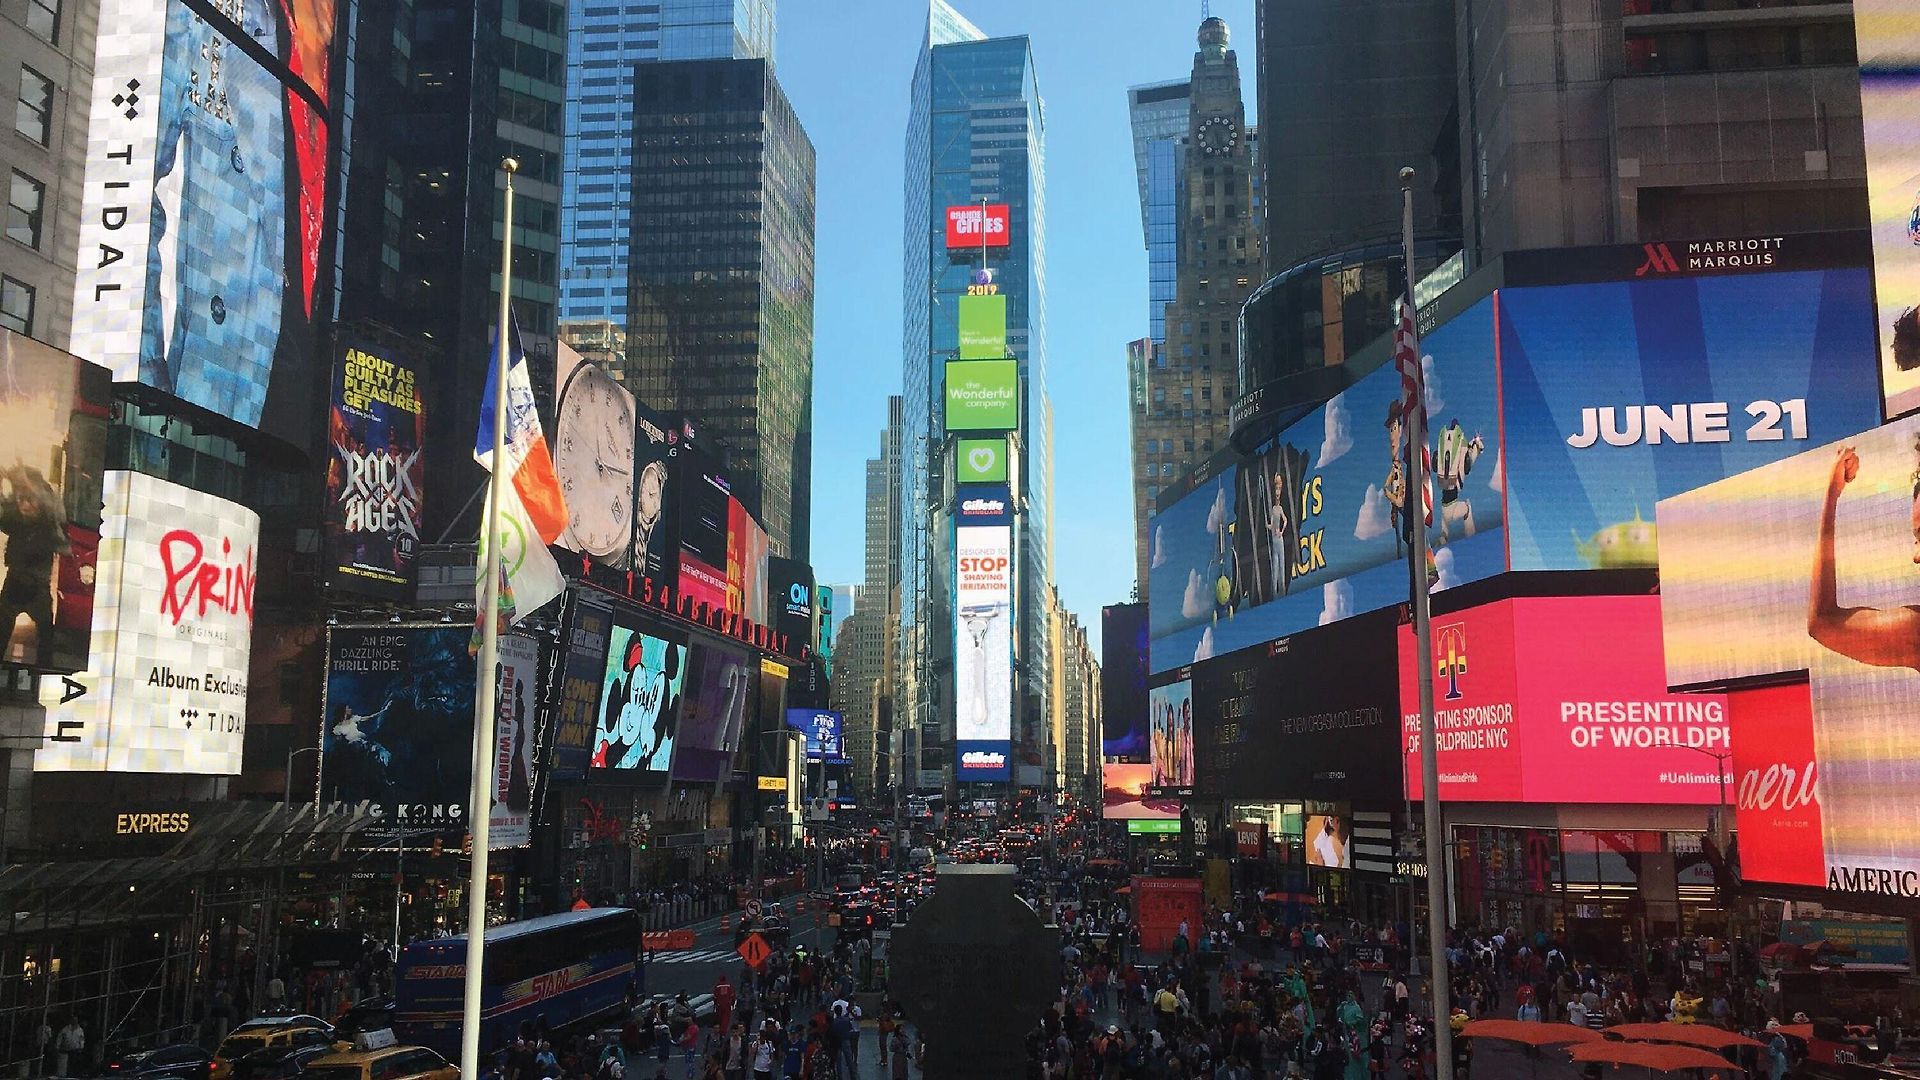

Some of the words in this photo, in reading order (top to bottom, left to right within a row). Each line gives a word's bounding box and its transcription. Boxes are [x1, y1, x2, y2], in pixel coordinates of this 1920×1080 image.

[94, 144, 133, 302] TIDAL
[1689, 237, 1784, 253] MARRIOTT
[1689, 253, 1774, 268] MARQUIS
[967, 285, 997, 296] 2019
[345, 348, 395, 377] ABOUT
[396, 367, 415, 384] AS
[345, 362, 393, 390] GUILTY
[395, 381, 413, 398] AS
[965, 381, 980, 390] the
[343, 390, 373, 413] GET.
[344, 375, 422, 415] PLEASURES
[949, 386, 1014, 400] Wonderful
[1567, 402, 1731, 449] JUNE
[1745, 398, 1808, 441] 21
[338, 440, 422, 502] ROCK
[962, 499, 1004, 511] Gillette
[345, 494, 420, 541] AGES
[960, 548, 996, 556] DESIGNED
[998, 548, 1008, 556] TO
[960, 558, 1008, 572] STOP
[790, 583, 809, 606] ON
[960, 583, 1007, 591] IRRITATION
[626, 570, 684, 615] 1540
[690, 592, 789, 654] BROADWAY
[179, 624, 228, 641] ORIGINALS
[341, 648, 393, 659] DAZZLING
[334, 660, 369, 671] THRILL
[148, 667, 200, 691] Album
[544, 650, 559, 703] MAC
[1404, 709, 1461, 732] PRENTING
[1463, 703, 1513, 727] SPONSOR
[1561, 702, 1723, 723] PRESENTING
[533, 711, 549, 764] MAC
[1408, 735, 1420, 753] OF
[1436, 729, 1485, 752] RLDPRIDE
[1486, 728, 1508, 749] NYC
[1571, 728, 1605, 748] OF
[961, 752, 1005, 763] Gillette
[398, 803, 462, 818] KONG
[117, 813, 189, 834] EXPRESS
[1193, 818, 1207, 833] BIG
[1826, 866, 1920, 898] AMERIC
